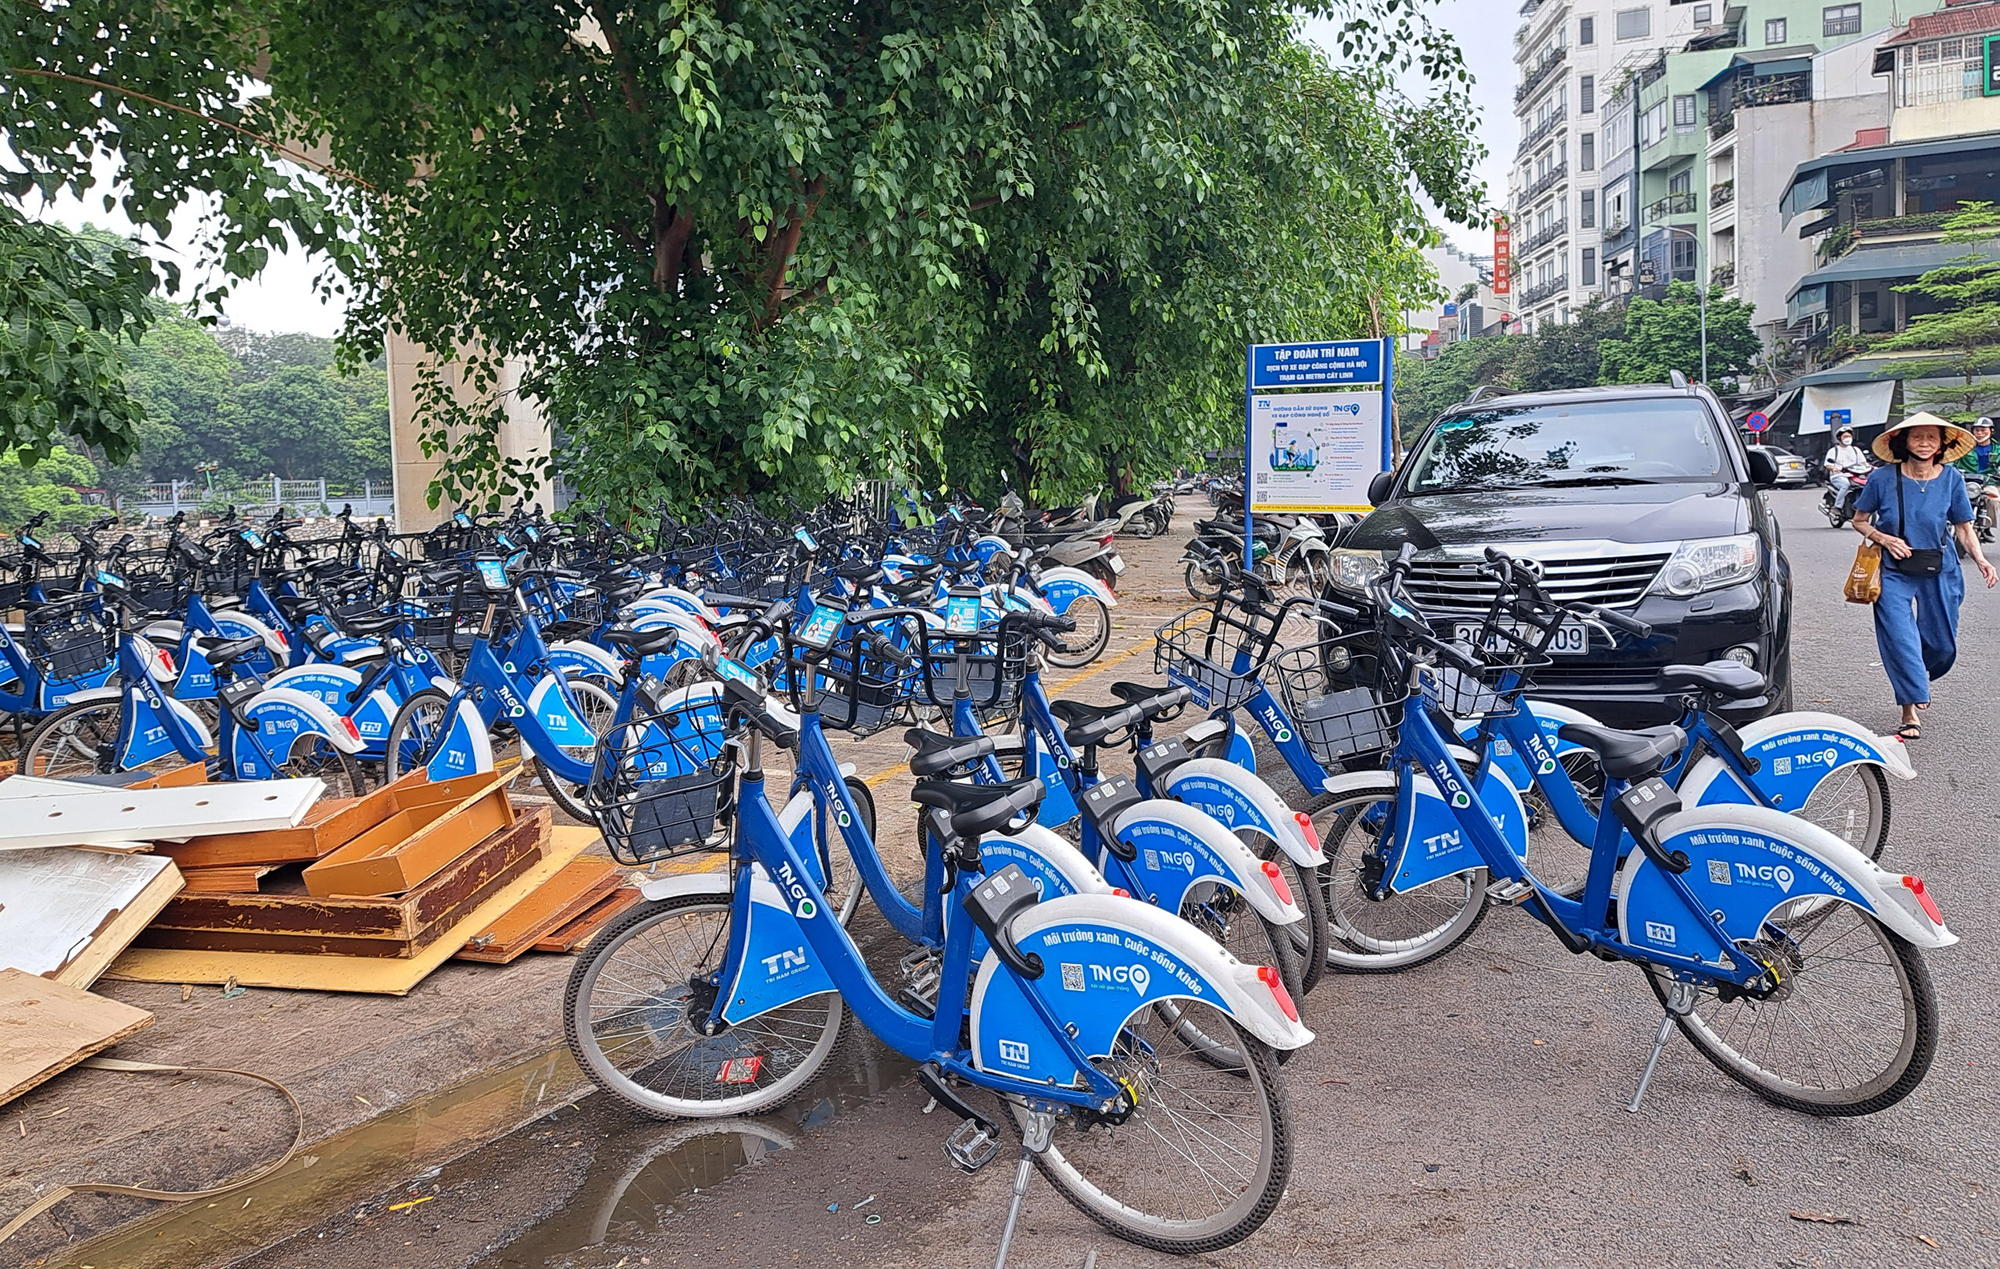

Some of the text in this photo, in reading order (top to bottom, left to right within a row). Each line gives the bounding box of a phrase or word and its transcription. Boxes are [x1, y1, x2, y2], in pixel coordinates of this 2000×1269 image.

[1274, 346, 1359, 362] TẬP ĐOÀN TRÍ NAM
[1266, 364, 1280, 372] DỊCH
[1281, 364, 1289, 372] VỤ
[1312, 362, 1328, 370] CÔNG
[1346, 360, 1354, 368] HÀ
[1356, 360, 1367, 369] NỘI
[753, 640, 768, 653] TN
[190, 674, 211, 684] TN
[362, 722, 380, 732] TN
[547, 714, 567, 727] TN
[1761, 742, 1776, 752] Môi
[1777, 734, 1801, 746] trường
[1822, 733, 1839, 744] Cuộc
[1839, 736, 1855, 750] sống
[448, 750, 466, 765] TN
[1221, 786, 1234, 799] Cuộc
[1234, 796, 1249, 811] sống
[1246, 806, 1261, 826] khỏe
[1131, 827, 1141, 837] Môi
[1141, 824, 1160, 835] trường
[1176, 831, 1192, 846] Cuộc
[1193, 842, 1209, 860] sống
[1208, 855, 1225, 876] khỏe
[1423, 829, 1460, 853] TN
[1435, 850, 1446, 858] NAM
[1447, 845, 1464, 854] GROUP
[982, 847, 992, 857] Môi
[993, 844, 1012, 856] trường
[1029, 855, 1045, 871] Cuộc
[1044, 867, 1060, 886] sống
[1689, 832, 1846, 896] Môi trường xanh. Cuộc sống khỏe
[1648, 922, 1673, 941] TN
[761, 946, 806, 975] TN
[1043, 928, 1202, 995] Môi trường xanh. Cuộc sống khỏe
[776, 972, 789, 980] NAM
[790, 964, 810, 975] GROUP
[1001, 1041, 1027, 1061] TN
